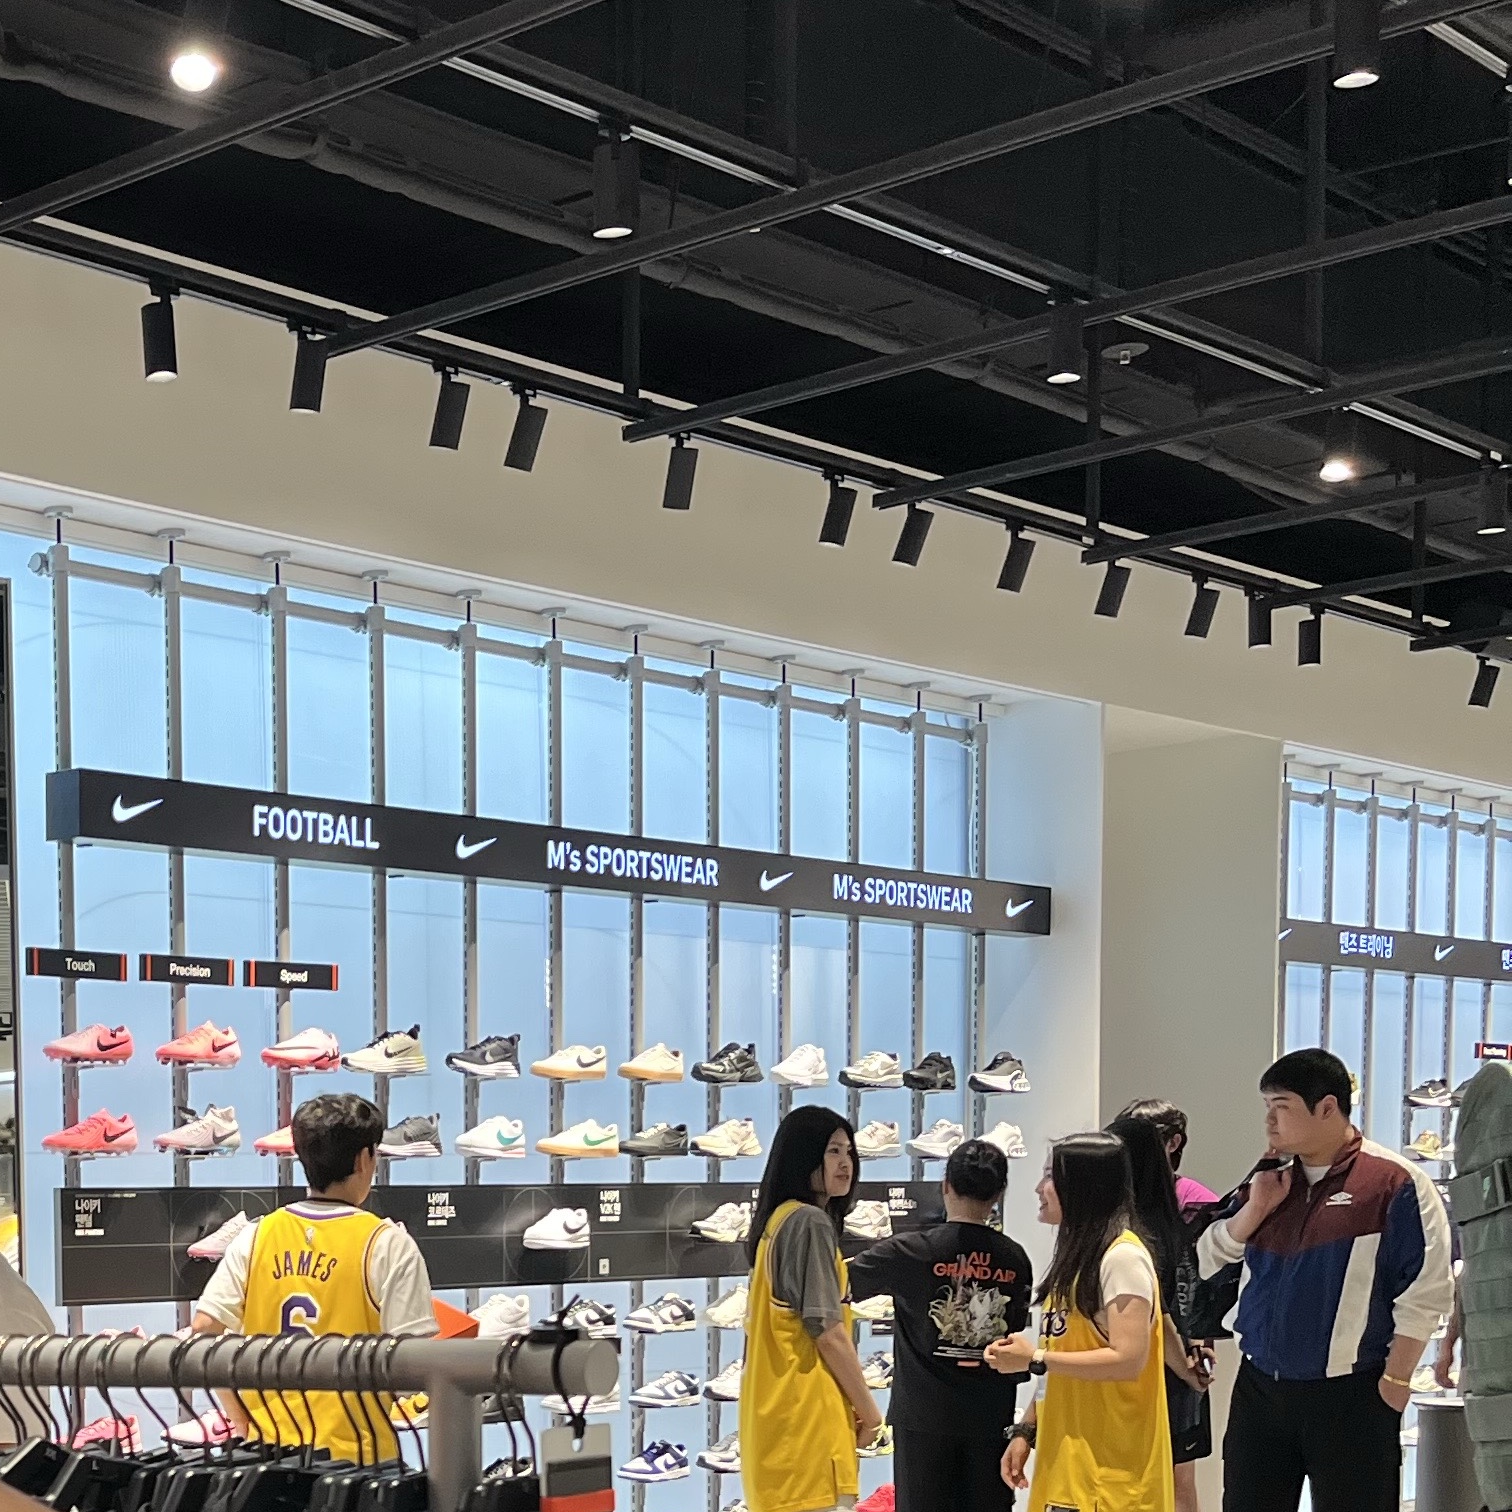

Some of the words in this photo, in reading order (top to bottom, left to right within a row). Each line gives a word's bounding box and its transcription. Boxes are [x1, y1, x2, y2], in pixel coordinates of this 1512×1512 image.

[253, 804, 380, 850] FOOTBALL
[547, 839, 581, 872] M's
[585, 844, 719, 887] SPORTSWEAR
[833, 873, 861, 902] M's
[864, 877, 973, 914] SPORTSWEAR
[1358, 933, 1394, 959] 트레이닝
[65, 956, 96, 973] Touch
[169, 962, 211, 978] Precision
[280, 968, 308, 983] Speed
[75, 1198, 102, 1214] 나이키
[272, 1249, 338, 1283] JAMES
[968, 1251, 991, 1266] AU
[933, 1262, 991, 1280] GRAND
